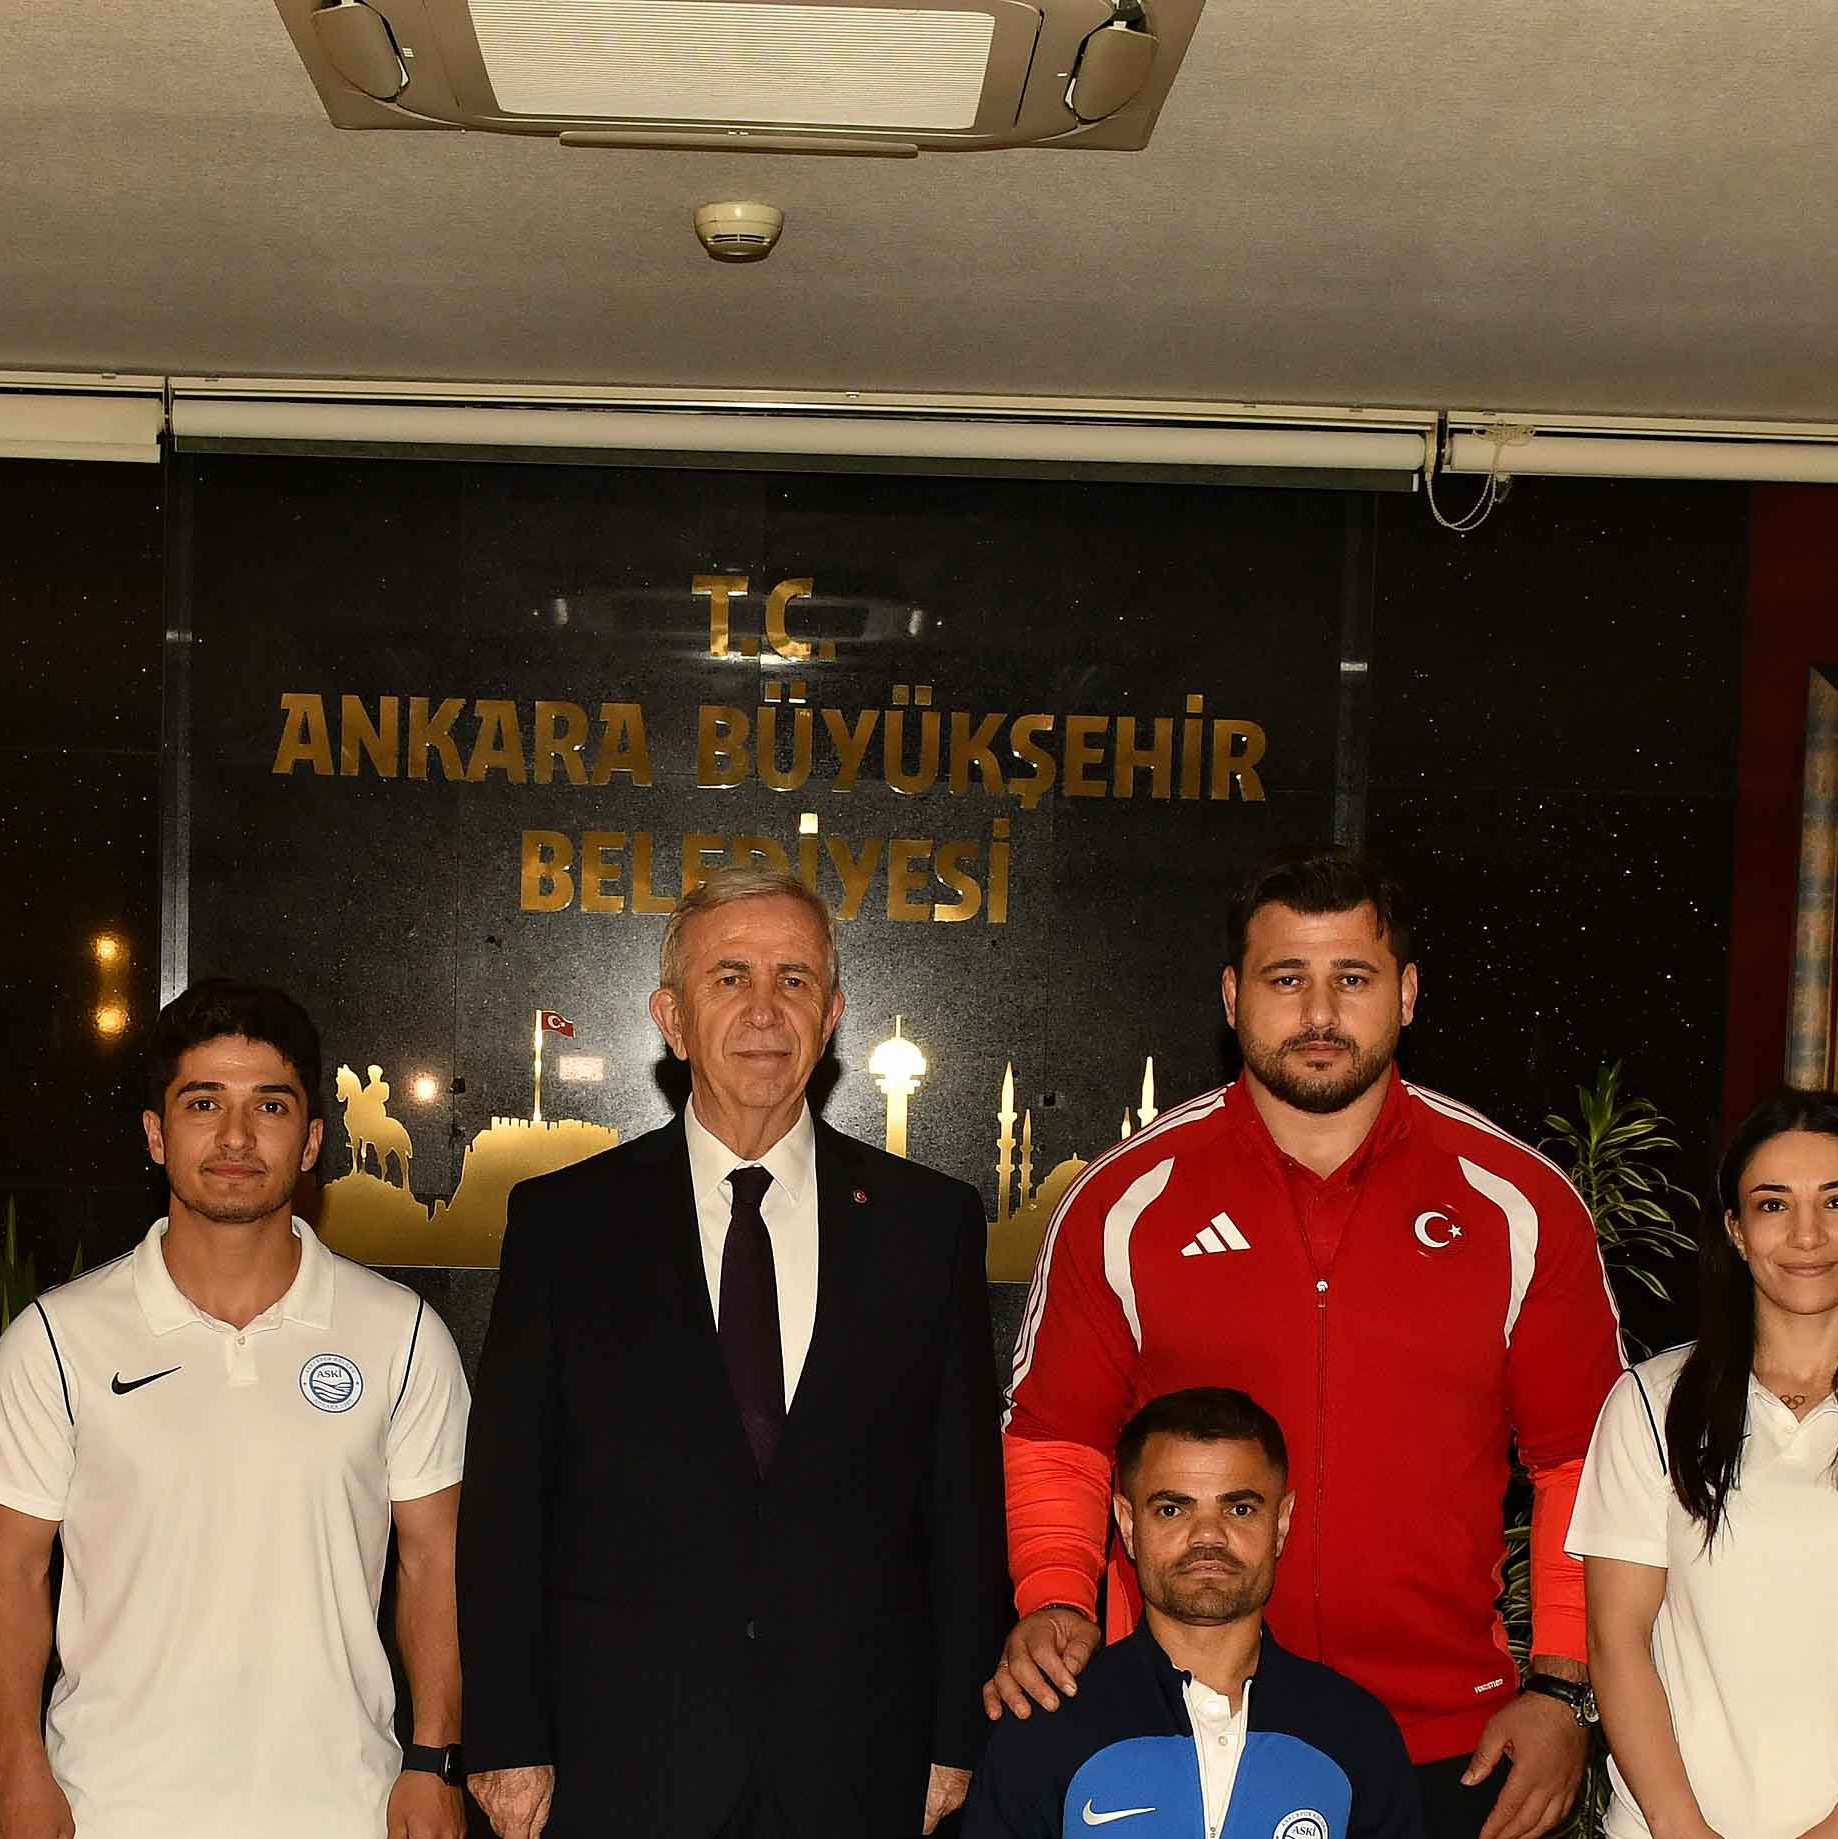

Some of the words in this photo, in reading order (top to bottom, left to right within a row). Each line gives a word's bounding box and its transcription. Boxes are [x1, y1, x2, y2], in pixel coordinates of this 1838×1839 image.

[692, 574, 837, 662] T.C.
[271, 691, 652, 789] ANKARA
[695, 683, 1268, 810] BÜYÜKŞEHİR
[316, 1367, 343, 1379] ASKİ
[1291, 1824, 1316, 1837] ASKİ
